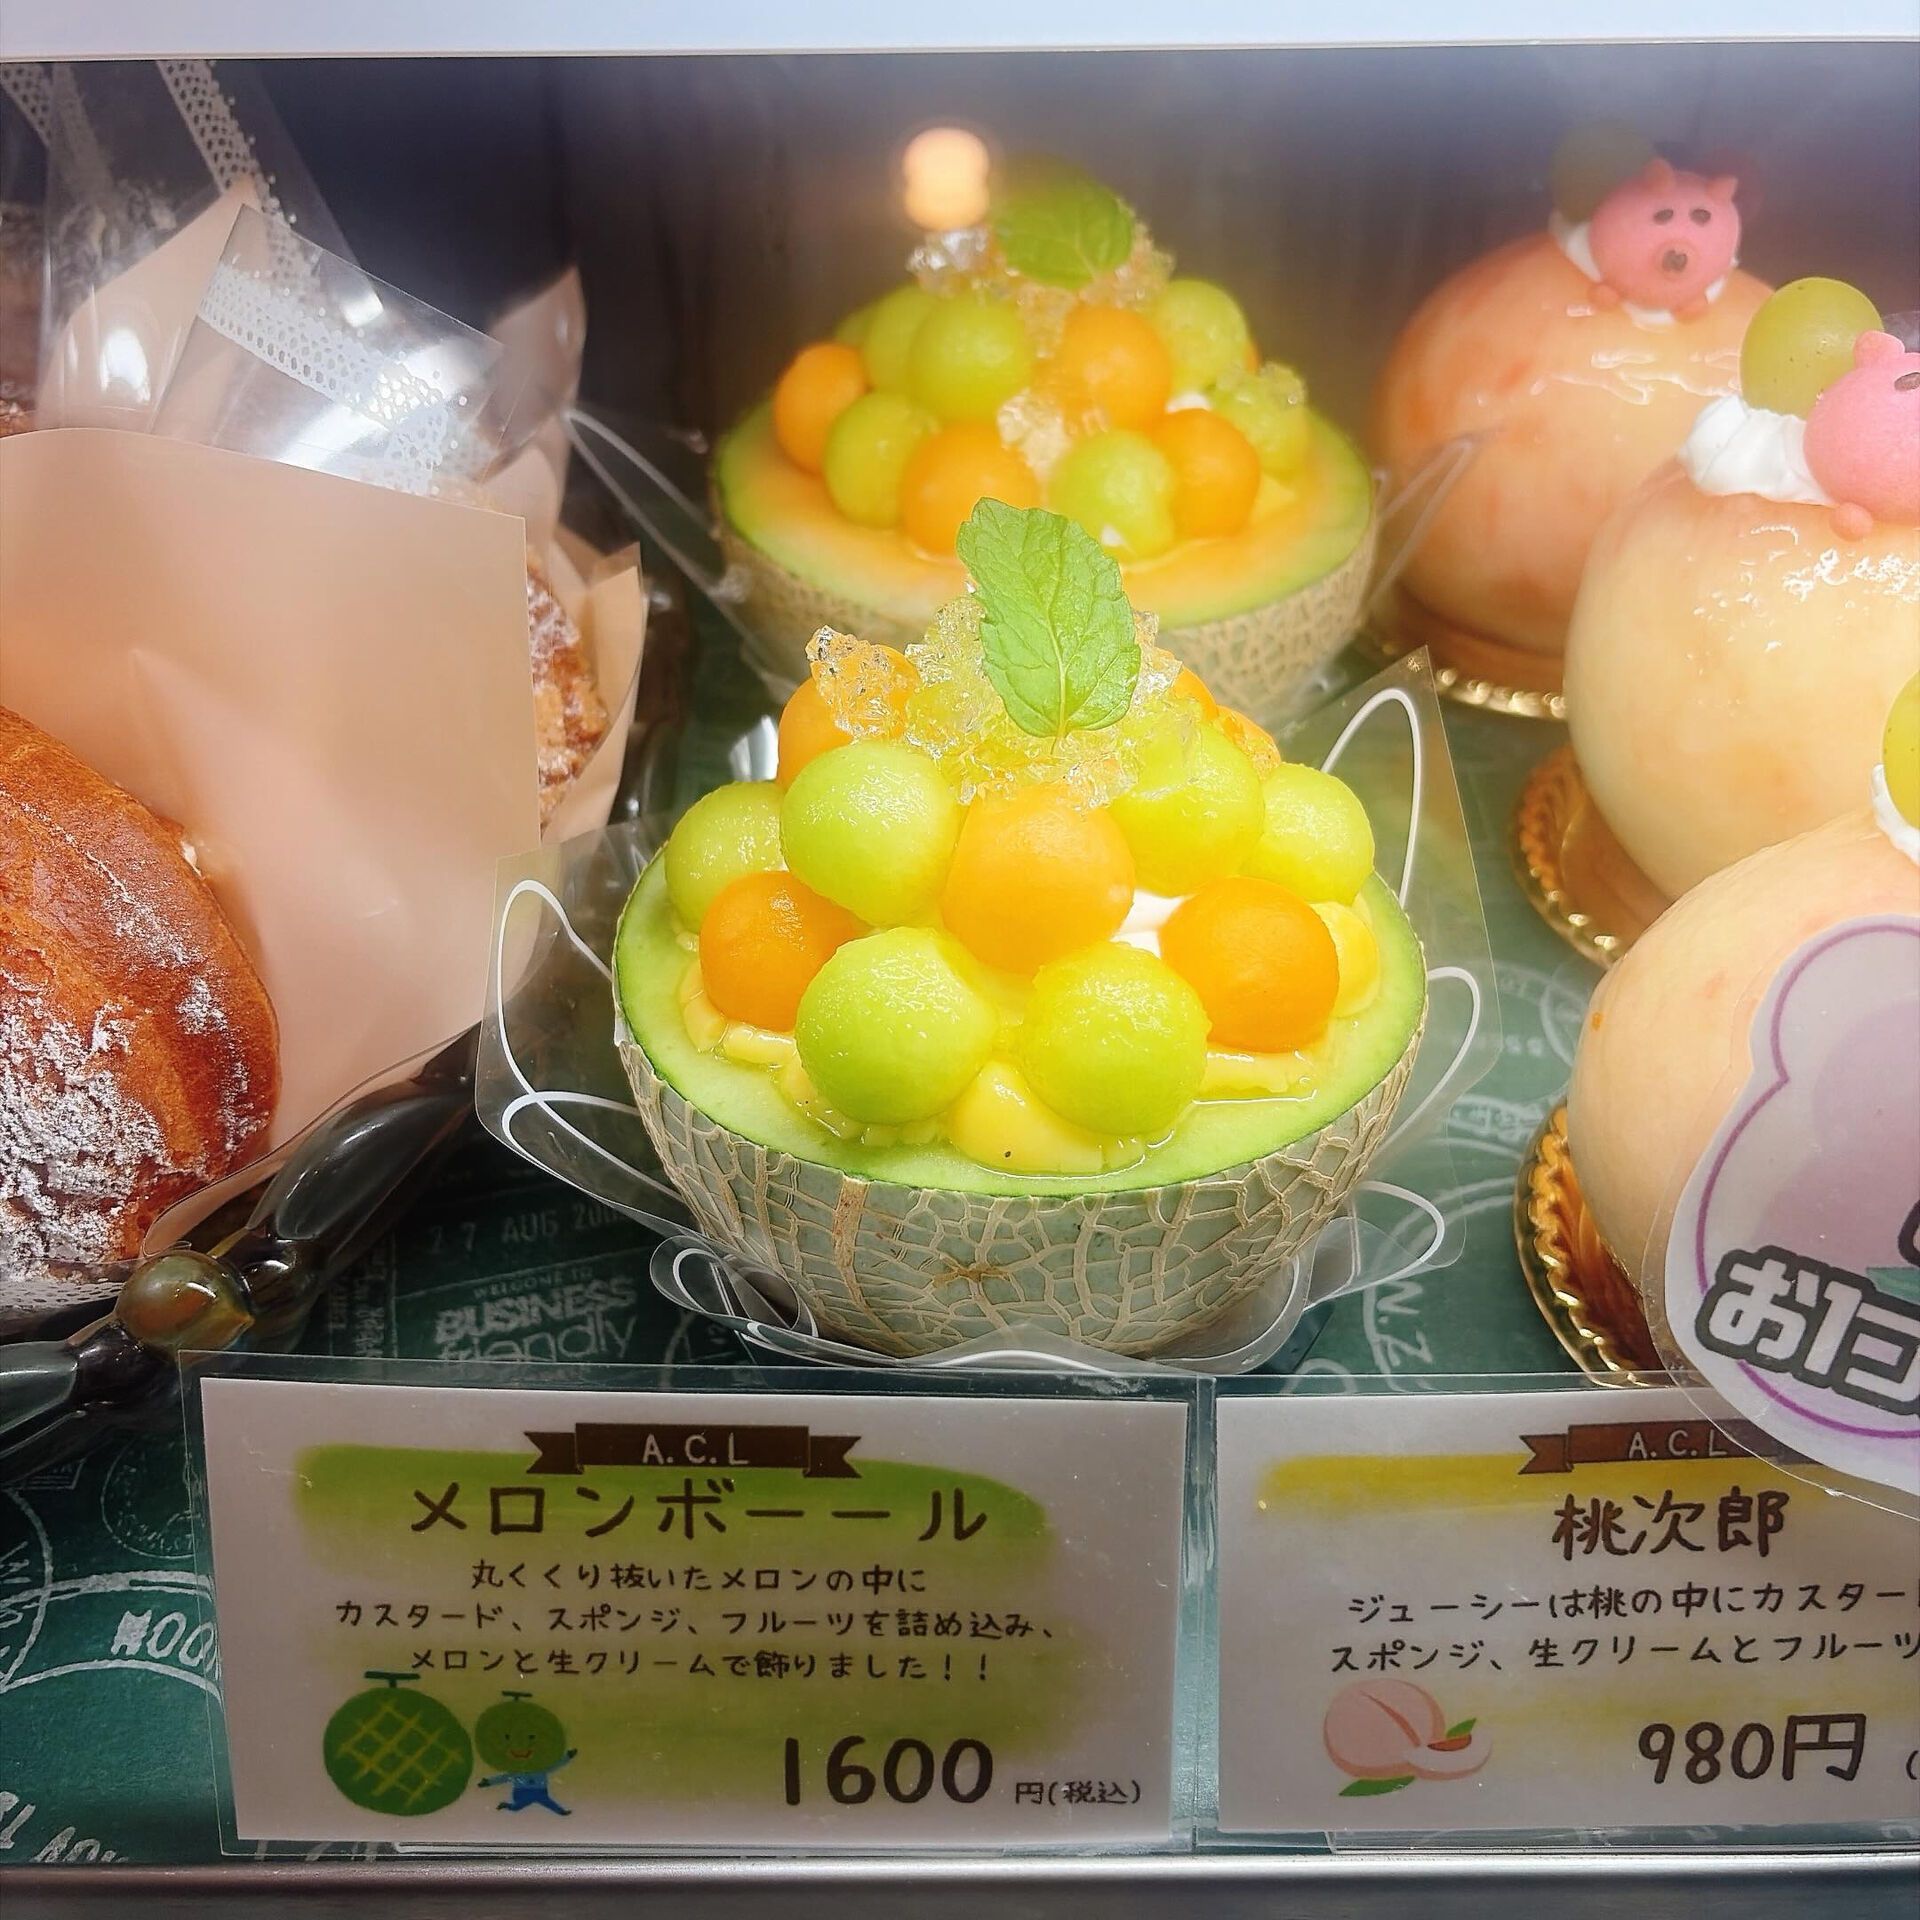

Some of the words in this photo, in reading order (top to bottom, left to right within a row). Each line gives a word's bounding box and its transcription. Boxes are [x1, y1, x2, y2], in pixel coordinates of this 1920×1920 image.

[435, 1277, 637, 1345] BUSINESS
[642, 1433, 750, 1465] A.C.L
[1628, 1429, 1729, 1460] A.C.L
[411, 1477, 987, 1541] メロンボーール
[1552, 1486, 1790, 1561] 桃次郎
[471, 1558, 926, 1596] 丸くくり抜いたメロンの中に
[1347, 1579, 1920, 1624] ジューシーは桃の中にカスター
[785, 1736, 993, 1807] 1600
[1638, 1713, 1868, 1785] 980円
